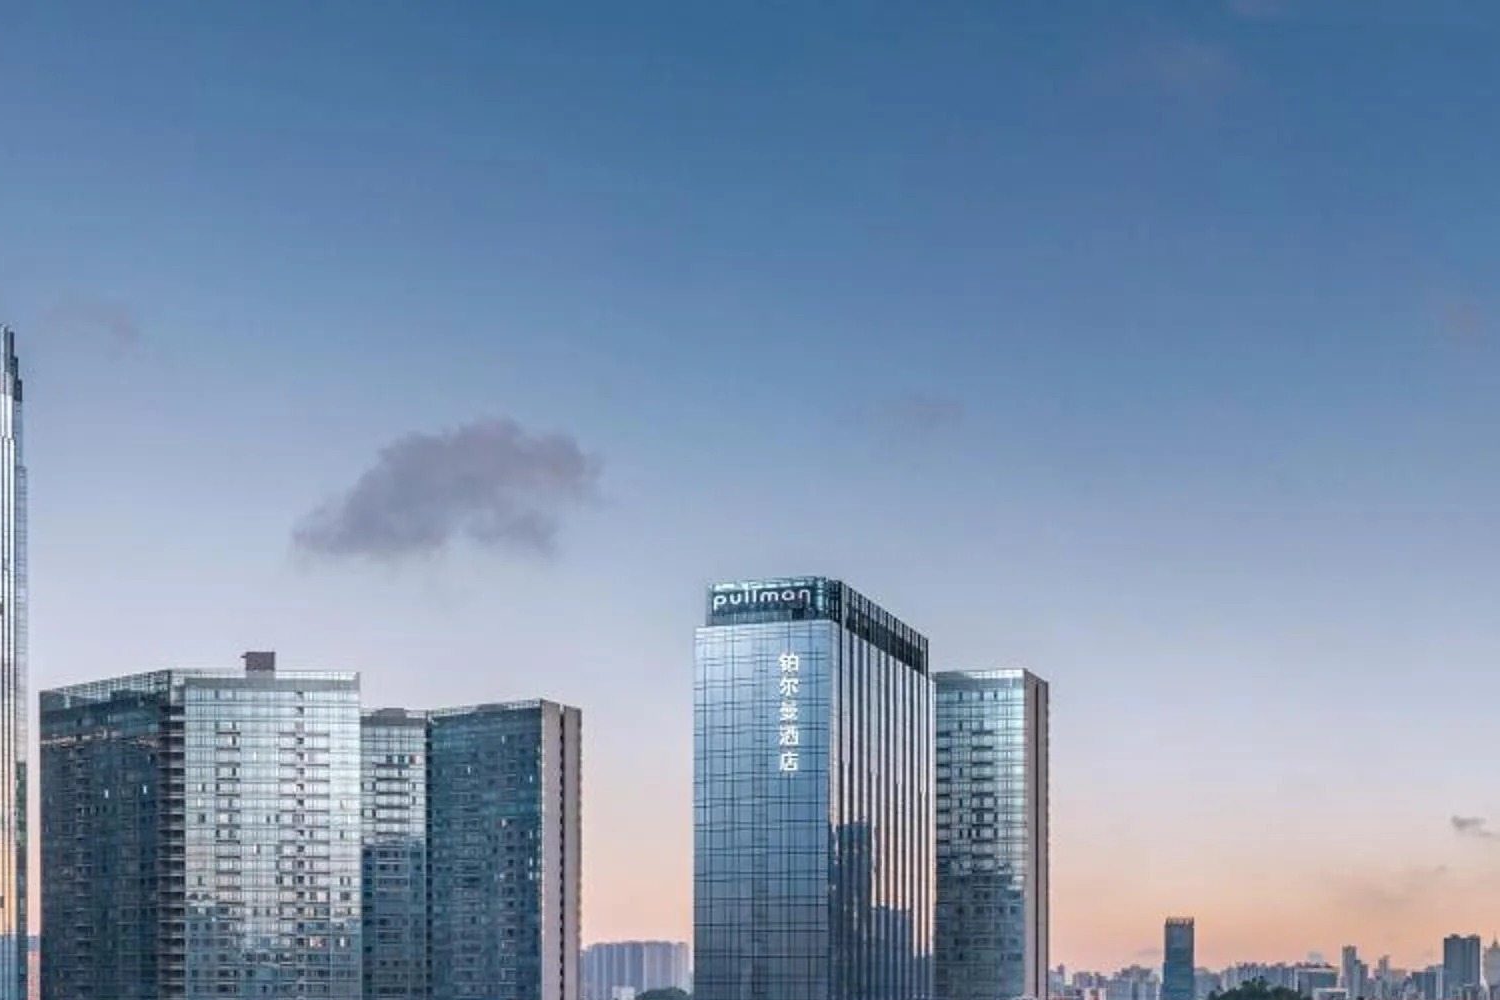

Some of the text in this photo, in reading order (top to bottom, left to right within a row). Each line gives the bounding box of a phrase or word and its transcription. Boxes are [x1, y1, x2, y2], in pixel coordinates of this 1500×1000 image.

[713, 589, 811, 611] pullman
[779, 653, 800, 772] 铂尔曼酒店
